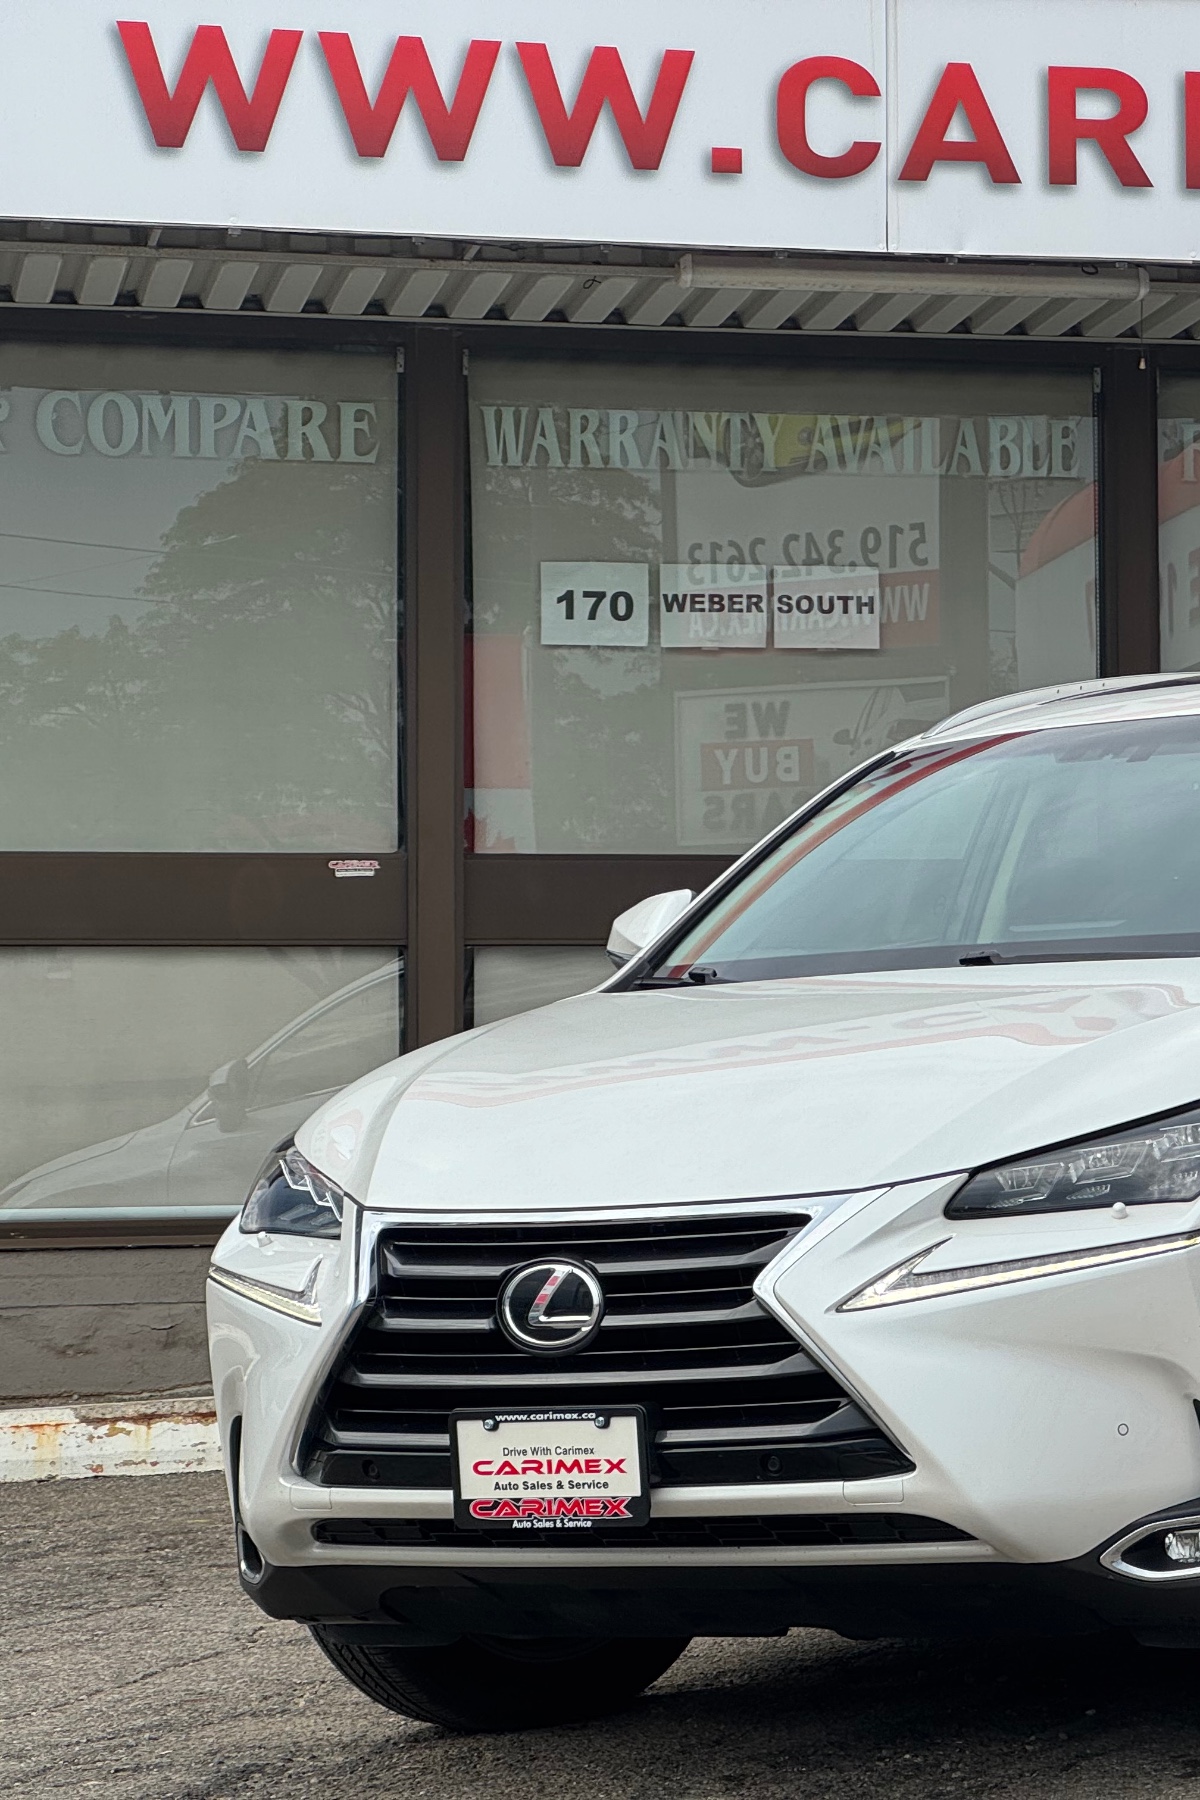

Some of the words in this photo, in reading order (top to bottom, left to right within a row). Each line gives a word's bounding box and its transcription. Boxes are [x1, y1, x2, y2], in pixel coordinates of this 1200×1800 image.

[36, 390, 378, 464] COMPARE
[480, 406, 783, 473] WARRANTY
[807, 414, 1080, 478] AVAILABLE
[555, 589, 634, 622] 170
[662, 593, 764, 613] WEBER
[777, 595, 875, 615] SOUTH
[495, 1411, 596, 1422] www.carimex.ca
[502, 1447, 528, 1456] Drive
[530, 1446, 552, 1456] With
[554, 1446, 595, 1455] Carimex
[472, 1458, 628, 1476] CARIMEX
[494, 1481, 519, 1491] Auto
[522, 1480, 553, 1490] Sales
[556, 1480, 565, 1490] &
[568, 1479, 609, 1490] Service
[470, 1497, 632, 1520] CARIMEX
[512, 1519, 532, 1529] Auto
[533, 1519, 555, 1528] Sales
[556, 1519, 563, 1528] &
[563, 1519, 592, 1528] Service
